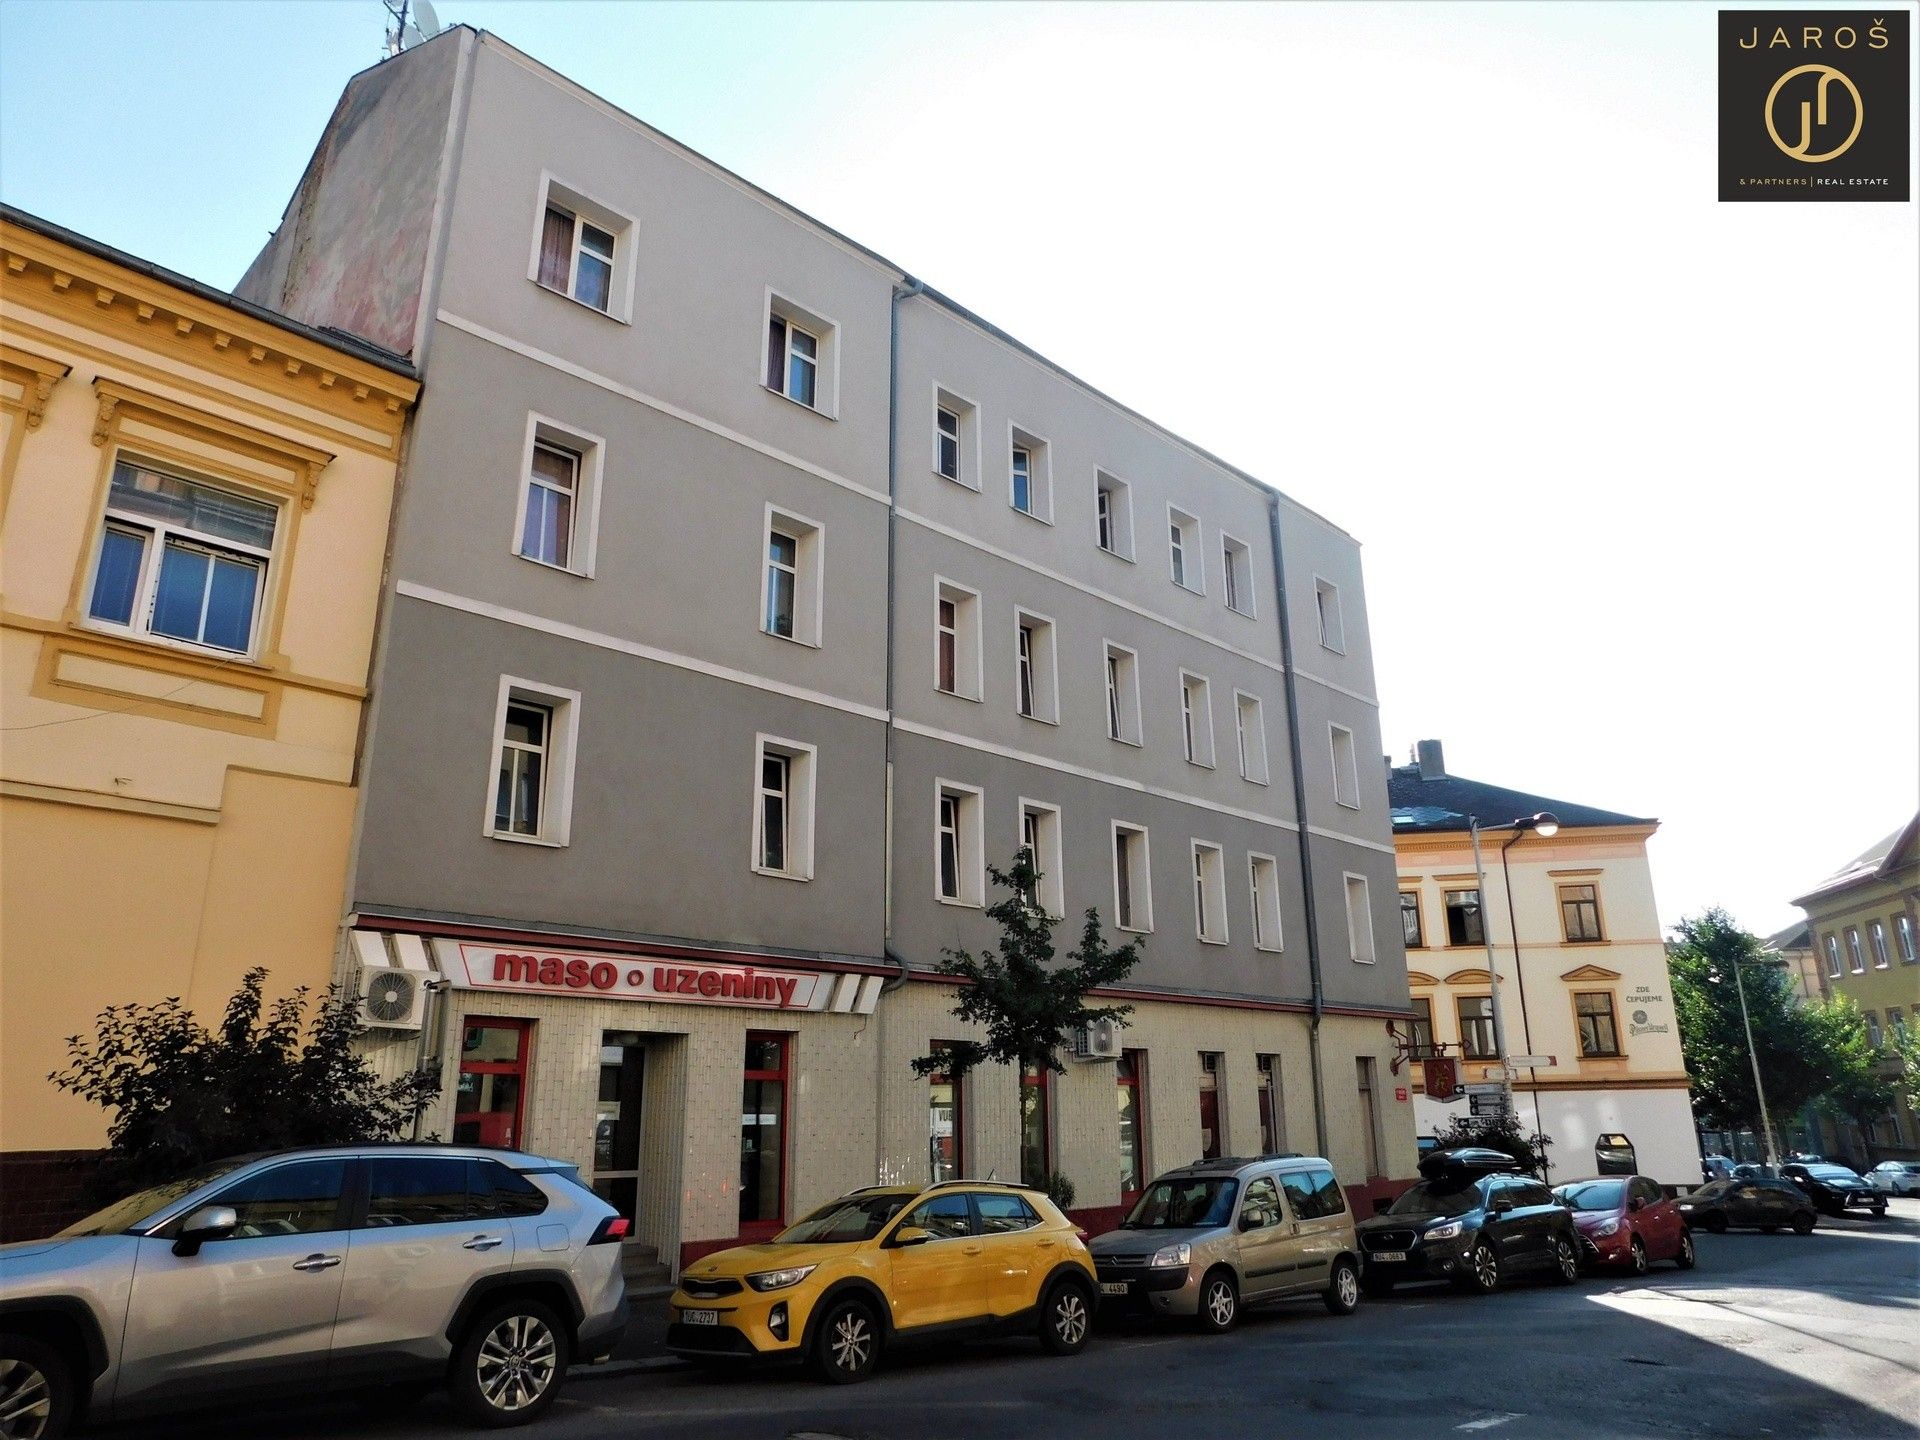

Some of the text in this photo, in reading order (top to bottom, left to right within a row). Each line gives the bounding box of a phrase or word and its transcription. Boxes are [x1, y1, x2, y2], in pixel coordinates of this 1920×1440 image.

[493, 953, 798, 1009] maso uzeniny
[1626, 995, 1663, 1003] ČEPUJEME
